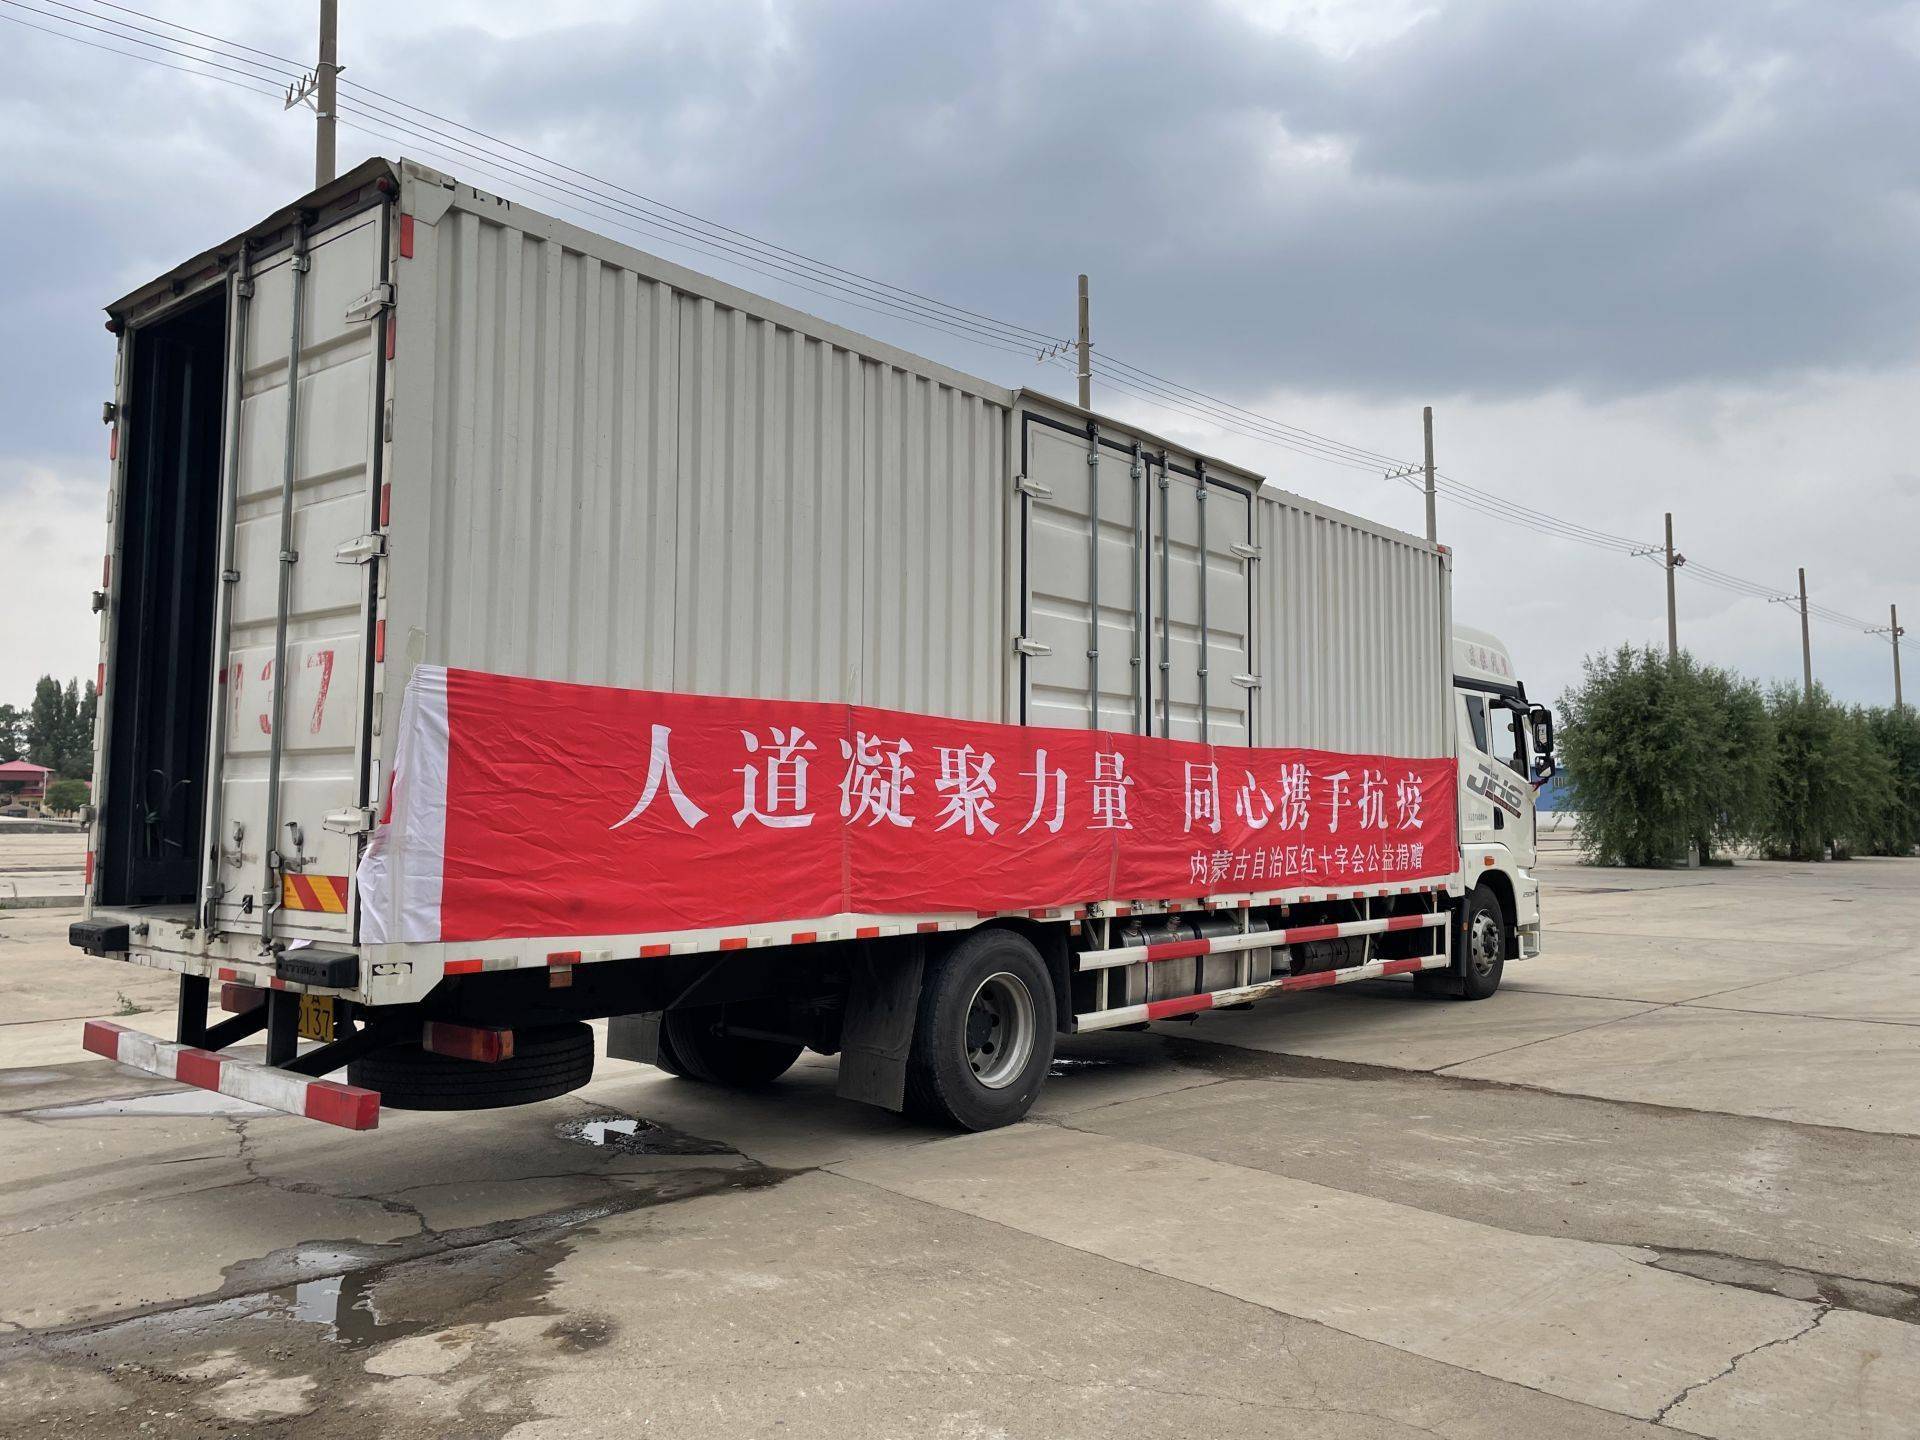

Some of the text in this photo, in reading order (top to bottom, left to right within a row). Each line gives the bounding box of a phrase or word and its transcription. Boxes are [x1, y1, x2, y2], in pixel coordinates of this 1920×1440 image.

[608, 723, 1424, 836] 人道凝聚力量 同心携手抗疫
[1190, 842, 1424, 885] 内蒙古自治区红十字会公益捐赠
